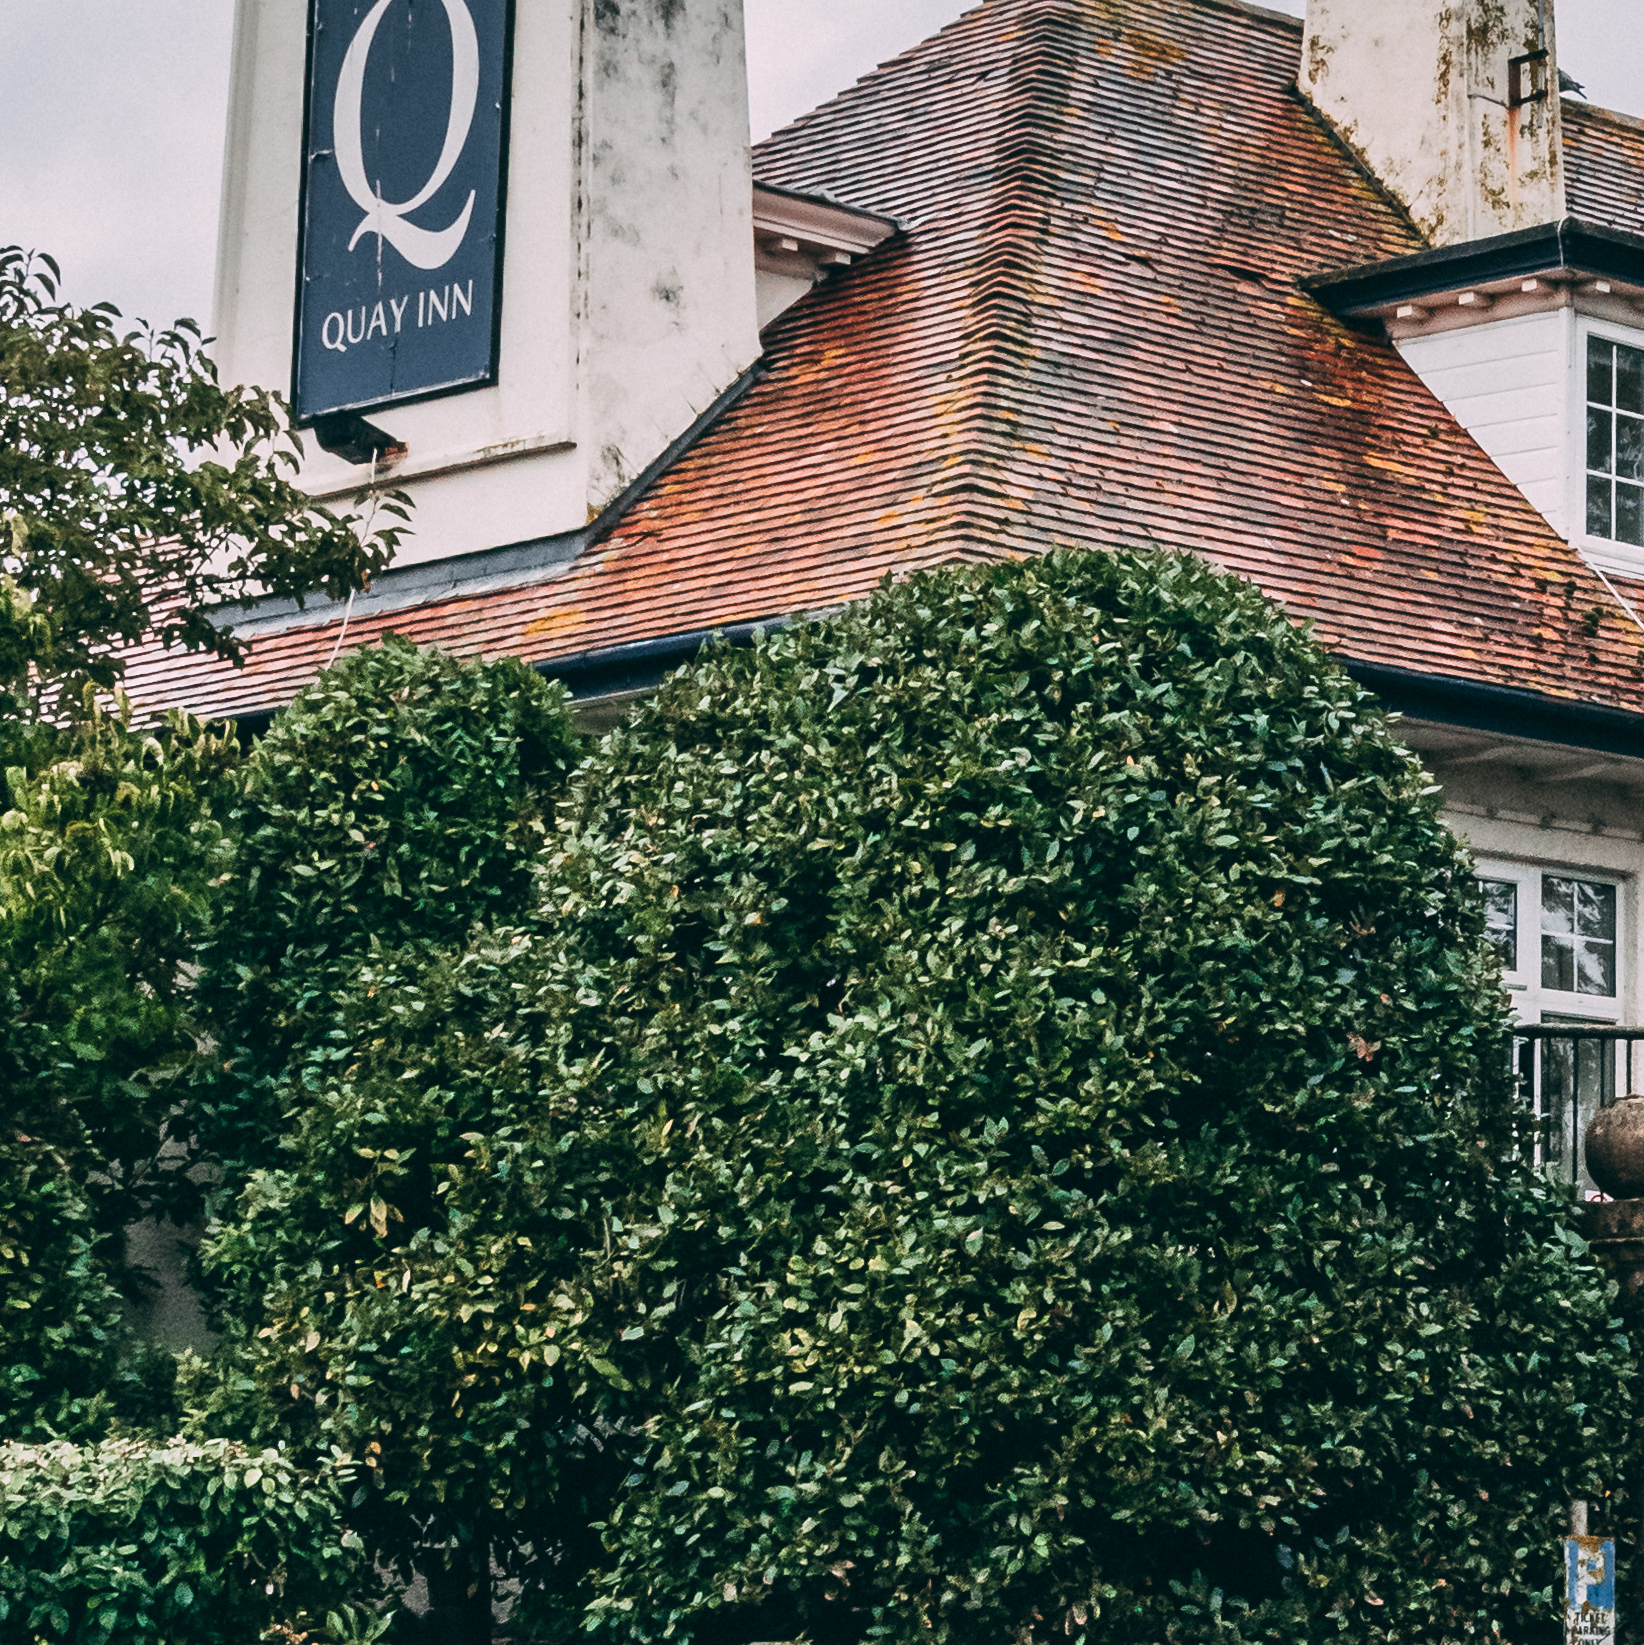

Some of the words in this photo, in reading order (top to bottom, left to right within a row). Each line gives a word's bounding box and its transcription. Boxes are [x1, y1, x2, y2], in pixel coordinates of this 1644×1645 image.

[321, 293, 408, 353] QUAY
[417, 278, 473, 328] INN
[1576, 1545, 1605, 1605] P
